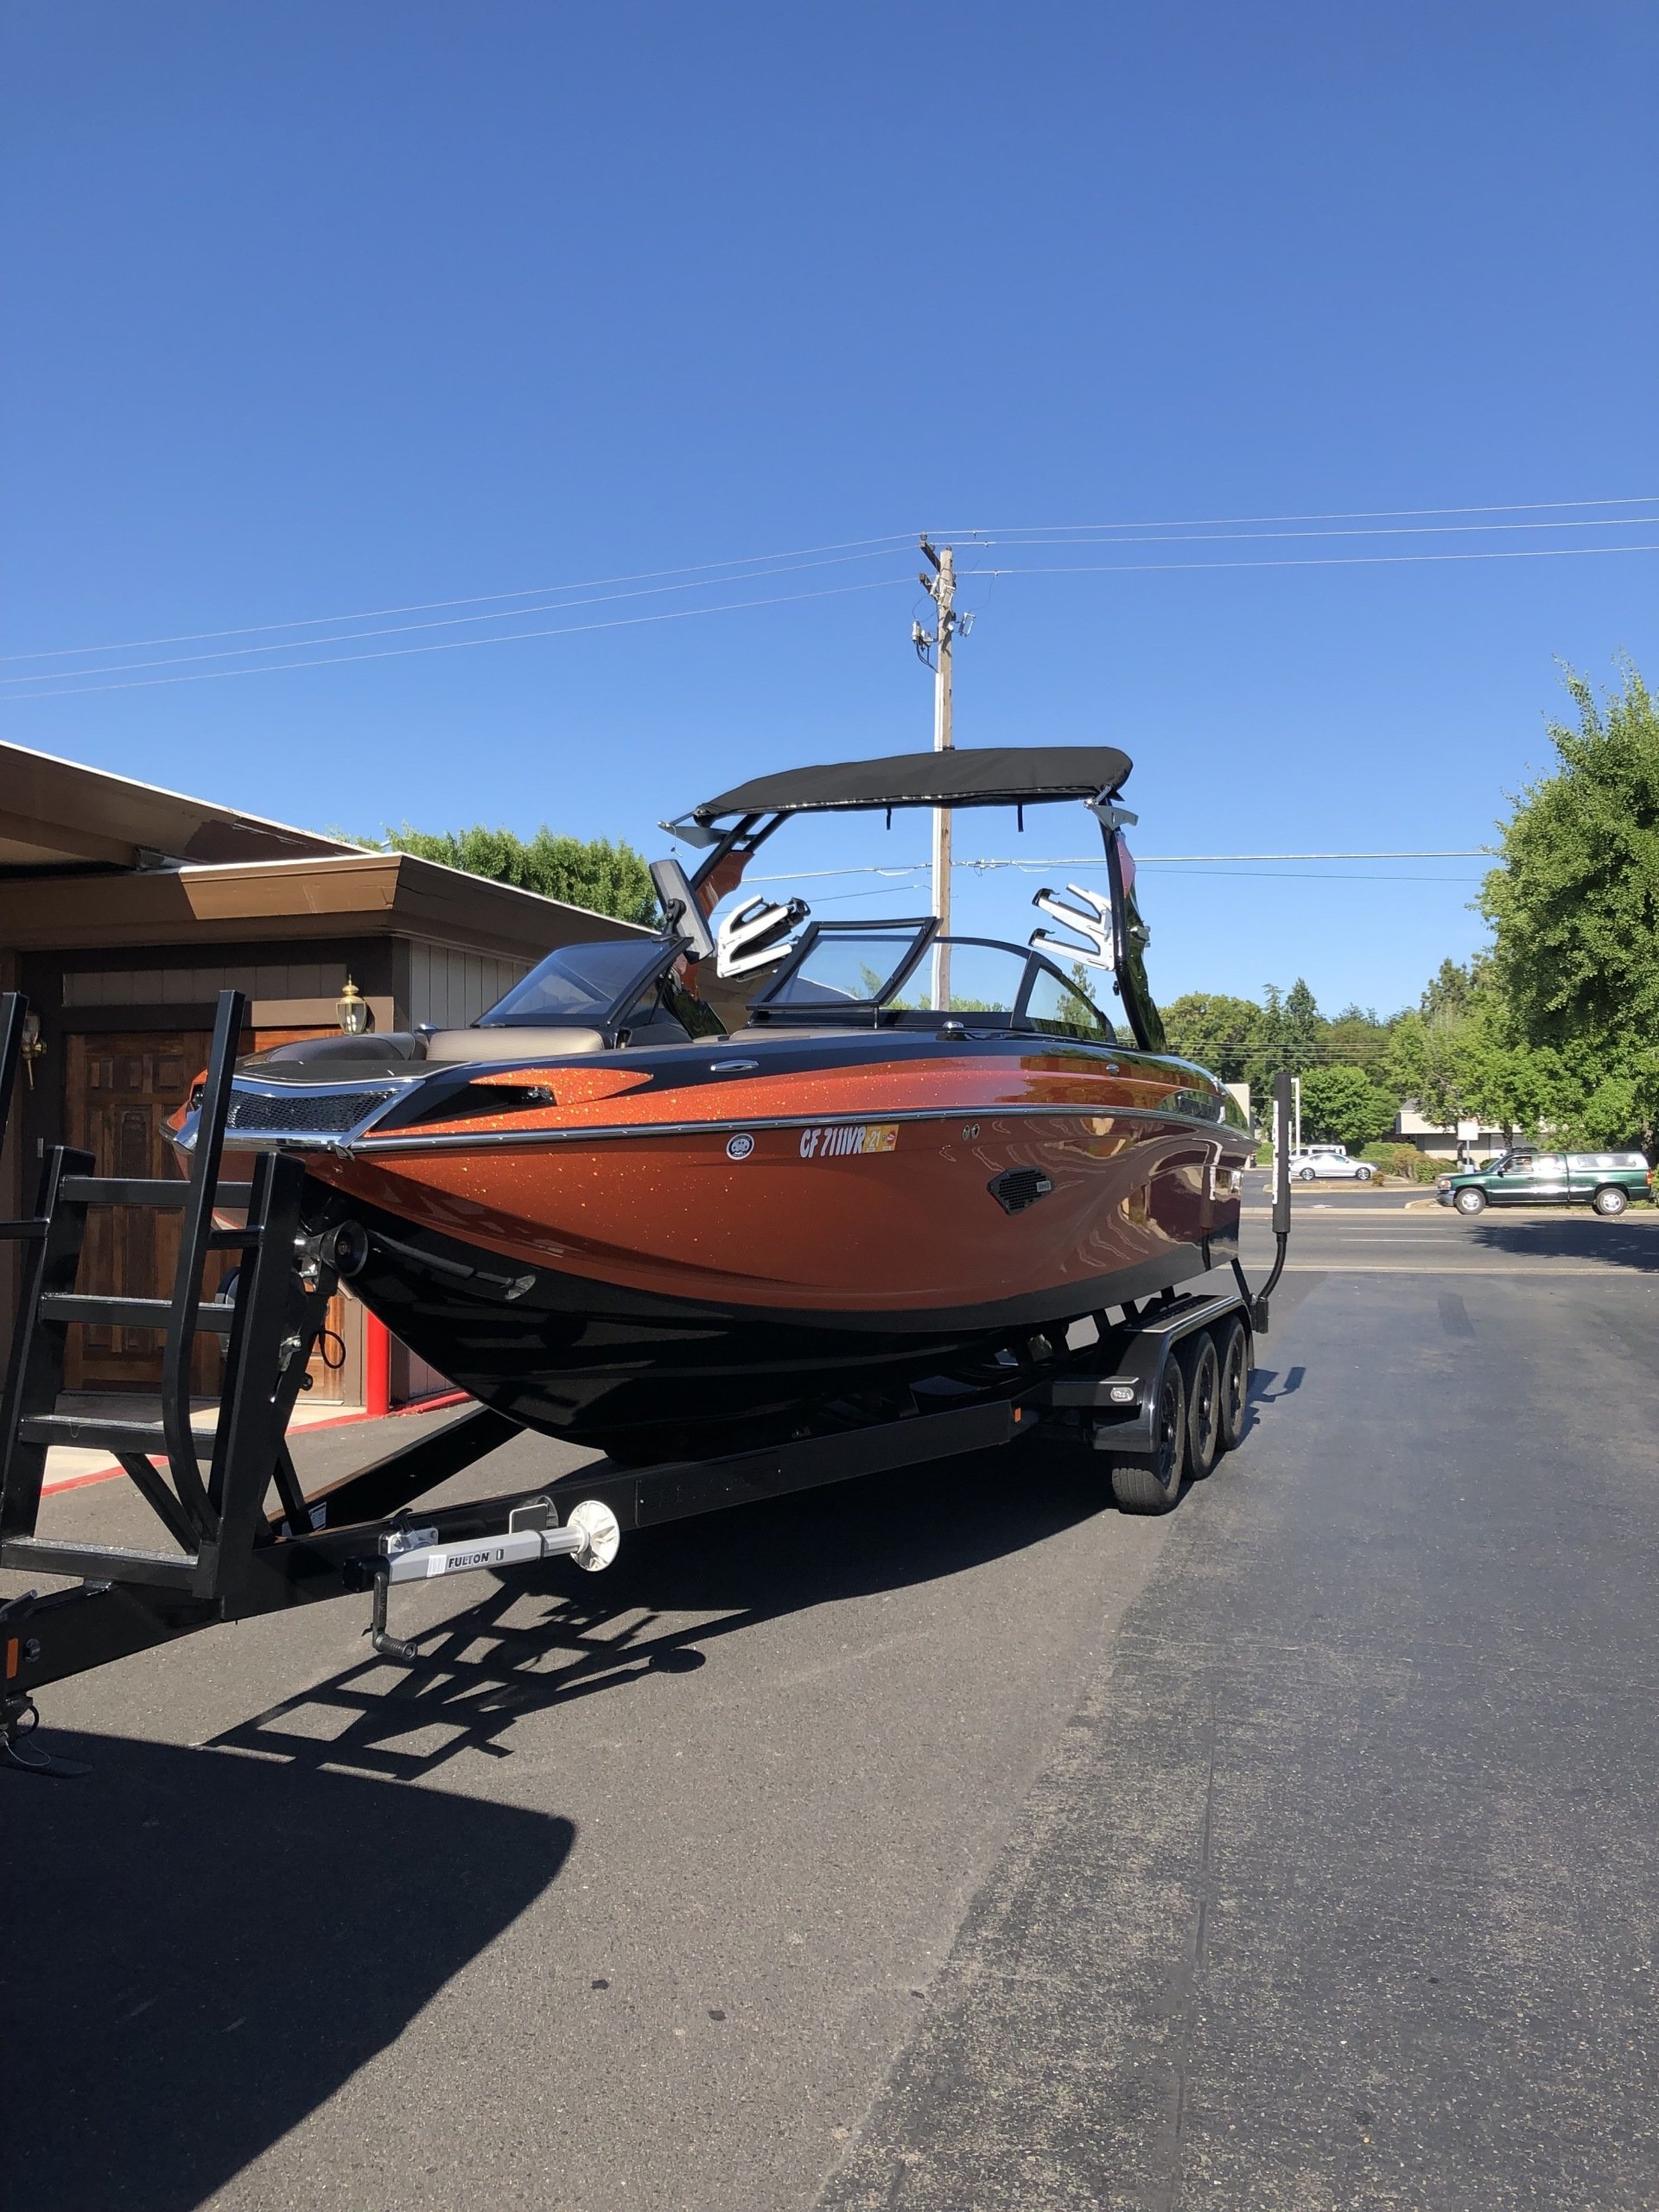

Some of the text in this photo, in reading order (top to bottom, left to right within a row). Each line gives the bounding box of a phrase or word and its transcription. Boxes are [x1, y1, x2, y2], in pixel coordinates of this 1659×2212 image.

[800, 1128, 821, 1158] CF
[869, 1130, 881, 1147] 21
[448, 1552, 490, 1568] FULTON
